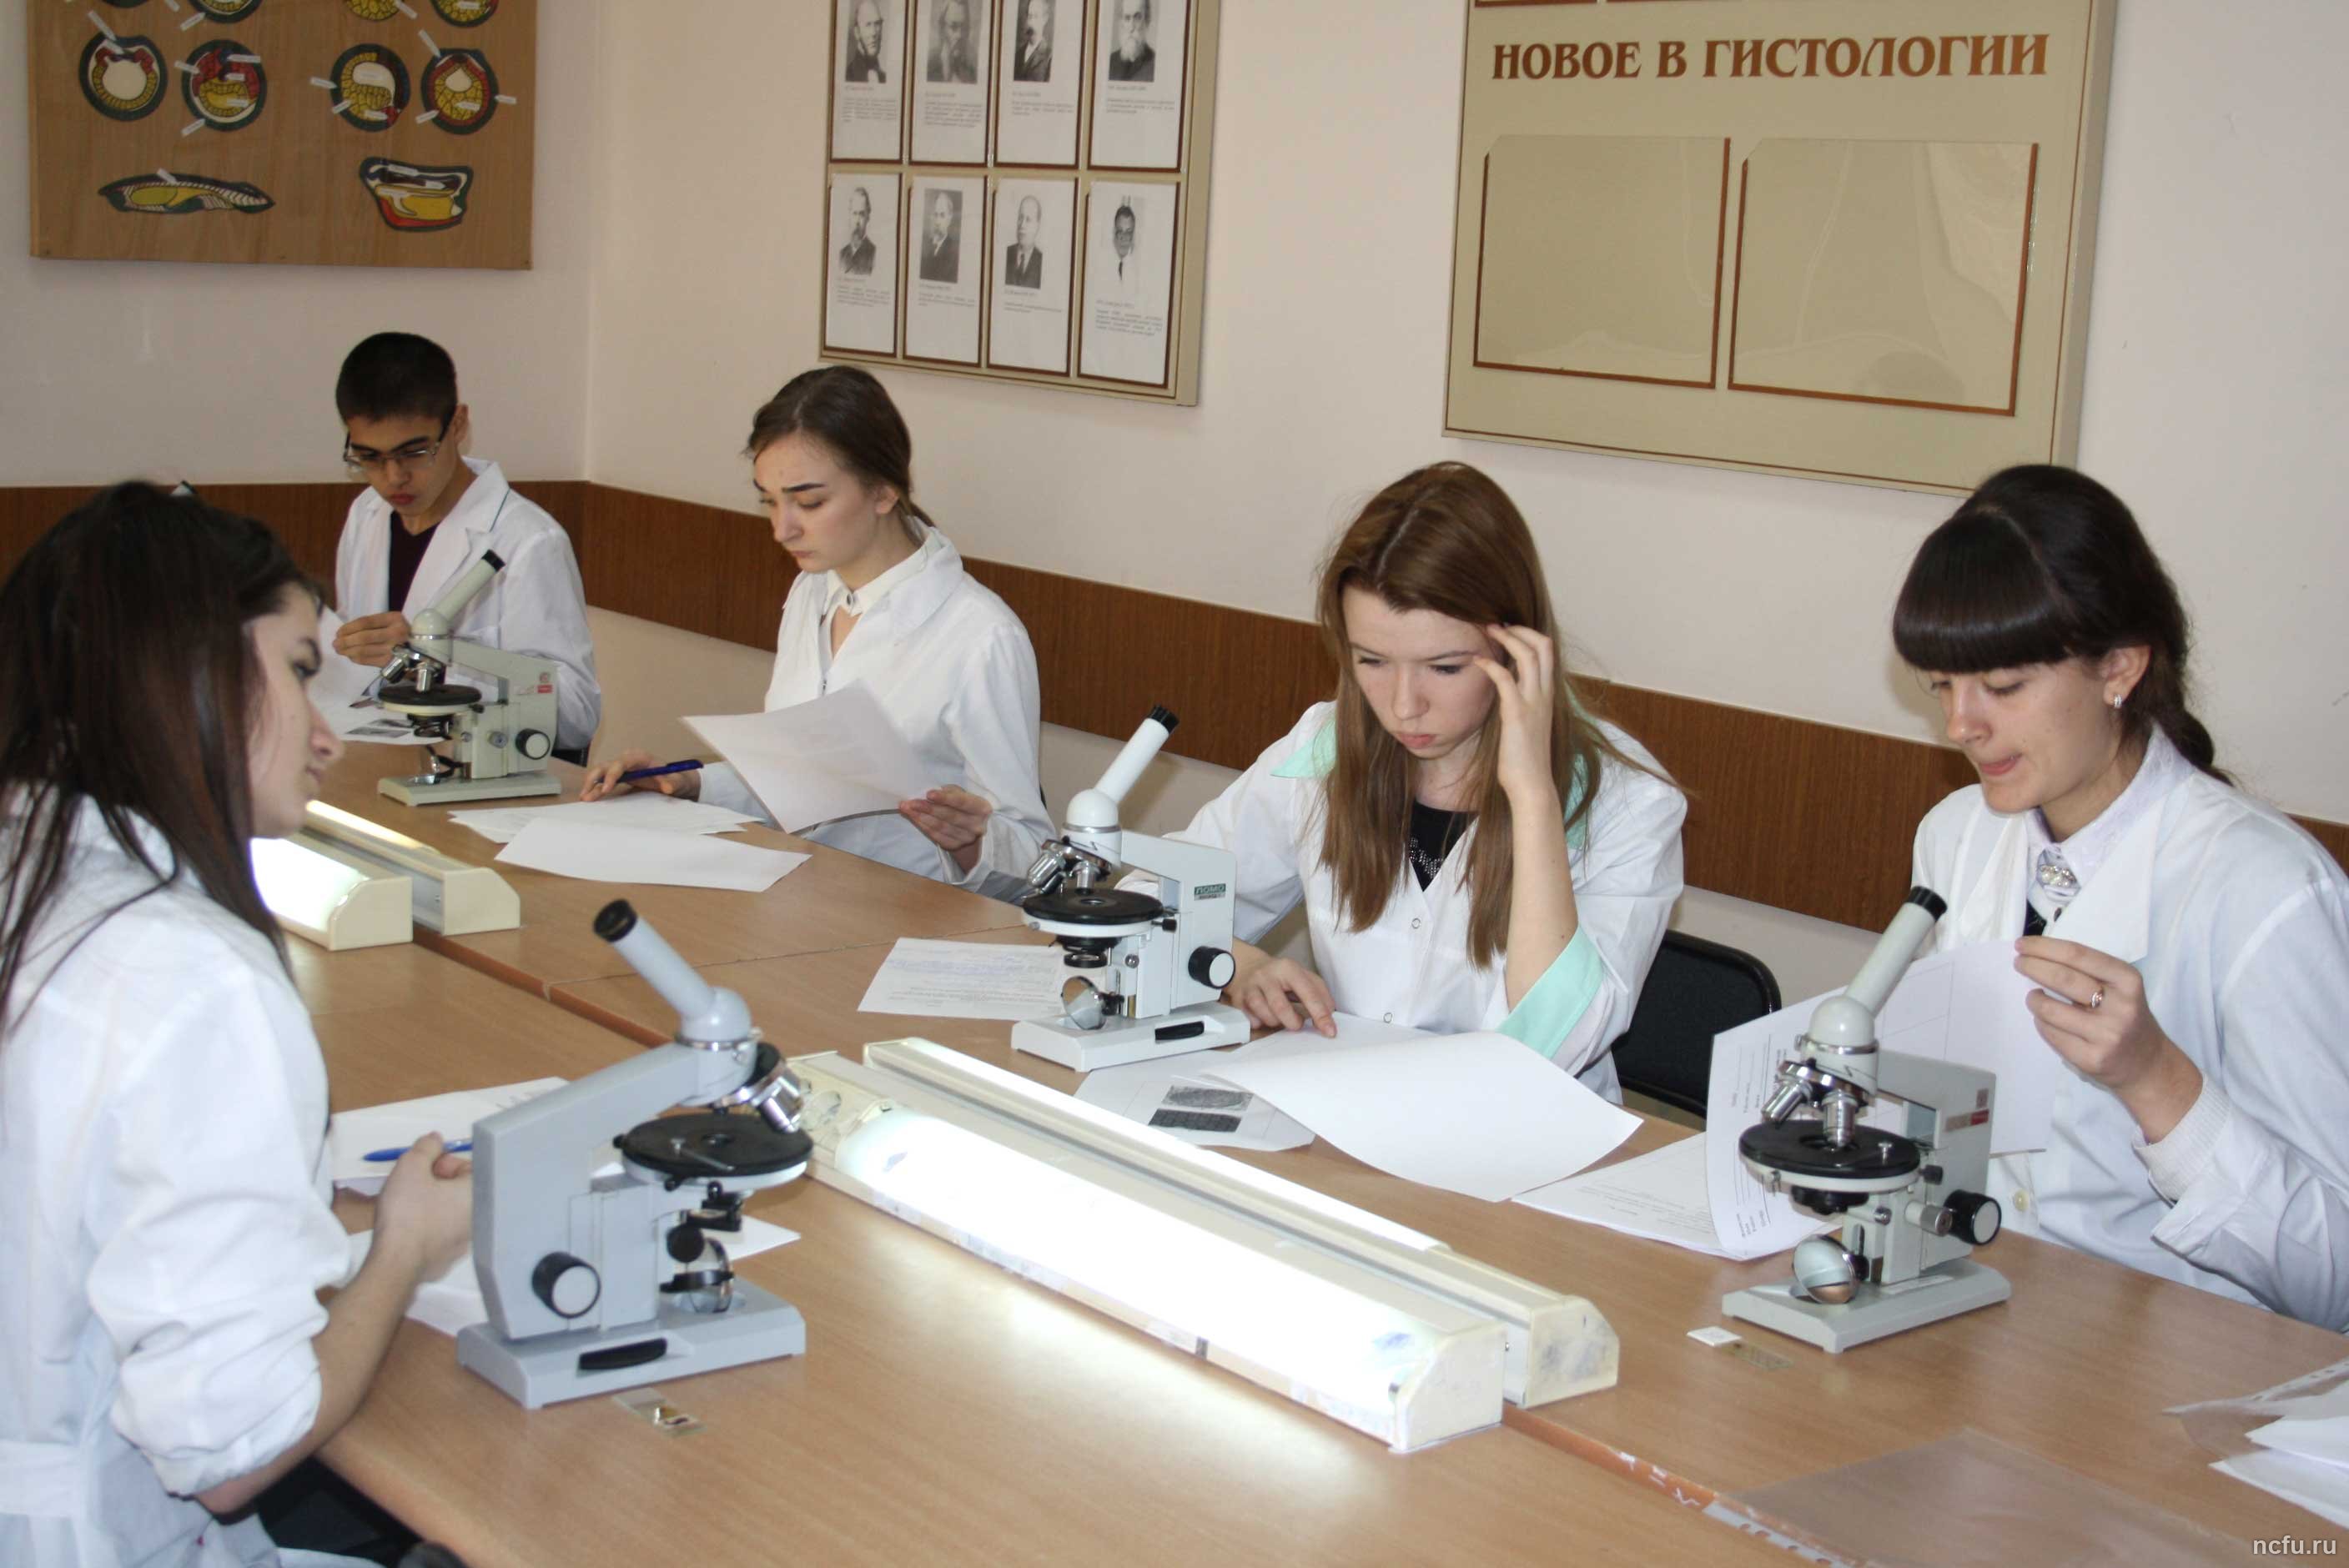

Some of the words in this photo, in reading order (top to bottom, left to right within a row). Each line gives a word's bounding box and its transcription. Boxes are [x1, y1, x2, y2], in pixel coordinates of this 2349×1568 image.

[1491, 41, 1642, 79] НОВОЕ
[1655, 40, 1688, 78] В
[1703, 33, 2050, 78] ГИСТОЛОГИИ
